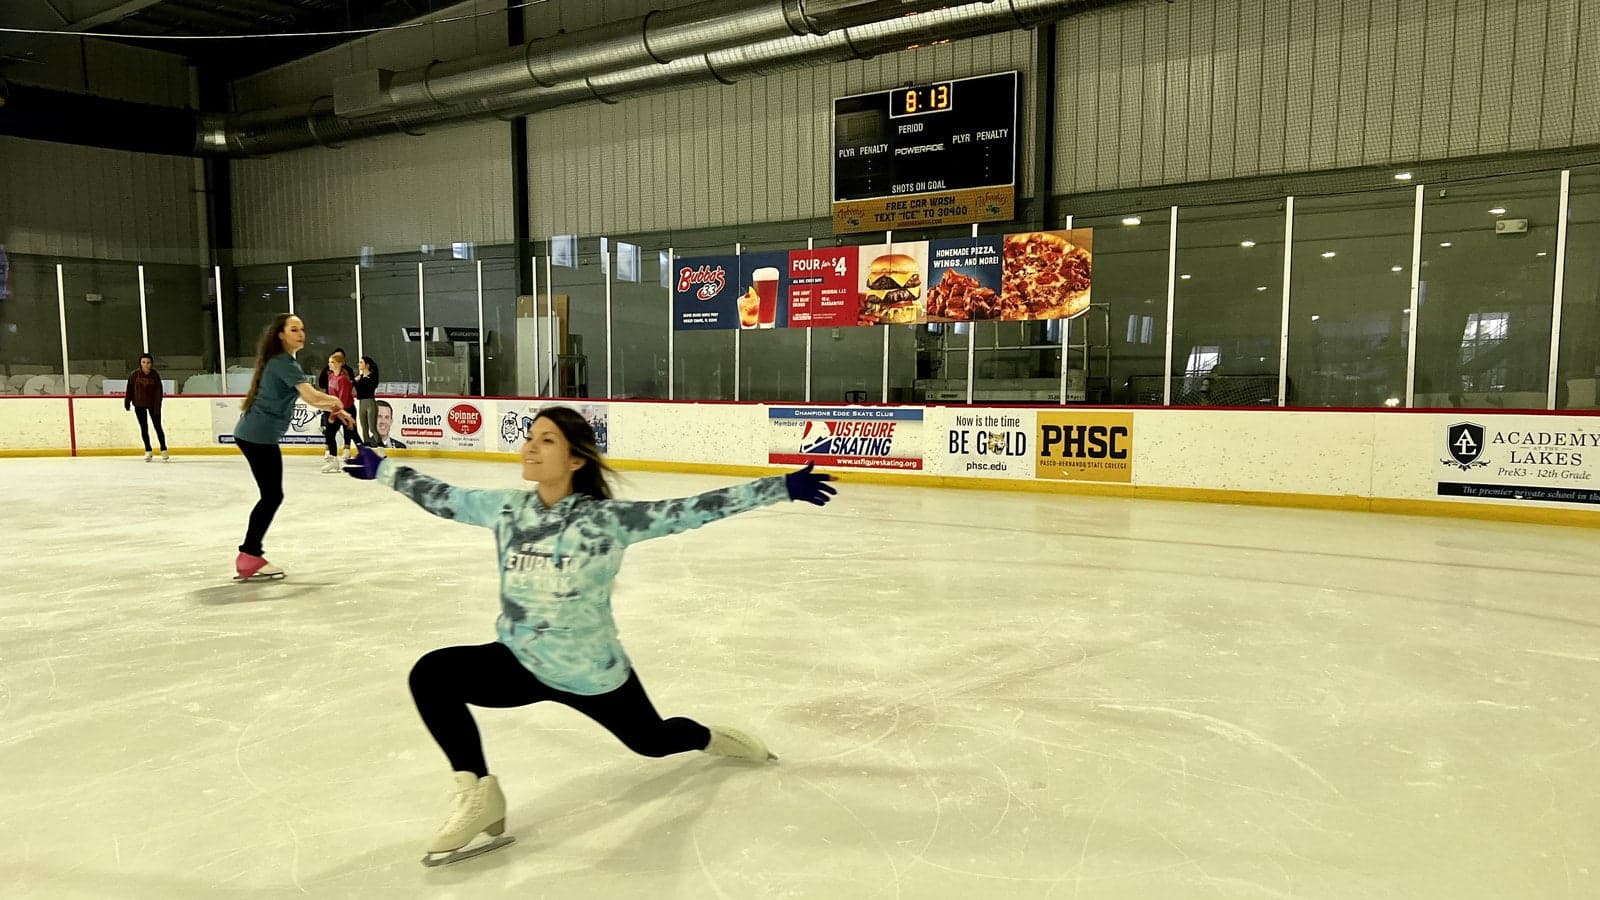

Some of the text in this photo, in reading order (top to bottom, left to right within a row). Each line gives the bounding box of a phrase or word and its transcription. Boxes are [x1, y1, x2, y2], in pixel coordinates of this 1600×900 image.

[906, 86, 948, 112] 8:13
[898, 122, 924, 135] PERIOD
[952, 128, 1009, 145] PLYR PENALTY
[838, 143, 889, 159] PLYR PENALTY
[894, 143, 945, 156] POWERADE
[891, 179, 947, 194] SHOTS ON GOAL
[885, 196, 956, 211] FREE CAR WASH
[874, 211, 896, 223] TEXT
[923, 208, 935, 219] TO
[938, 206, 968, 217] 30400
[936, 247, 970, 258] HOMEMADE
[792, 256, 847, 276] FOUR for $4
[933, 256, 999, 269] WINGS, AND MORE!
[677, 264, 726, 293] Bubba's
[701, 283, 718, 297] 33
[412, 403, 431, 414] Auto
[402, 414, 442, 426] Accident?
[449, 410, 479, 422] Spinner
[956, 414, 1020, 428] Now is the time
[836, 422, 896, 438] US FIGURE
[831, 437, 892, 456] SKATING
[949, 430, 970, 454] BE
[1041, 424, 1128, 460] PHSC
[1492, 432, 1600, 447] ACADEMY
[836, 458, 917, 468] www.usfigureskating.org
[1510, 450, 1583, 466] LAKES
[966, 460, 1007, 472] phsc.edu
[1104, 462, 1127, 470] COLLEGE
[1498, 467, 1527, 478] PreK3
[1537, 469, 1558, 479] 12th
[1560, 470, 1592, 480] Grade
[1463, 486, 1476, 494] The
[1479, 488, 1513, 497] premier
[1546, 490, 1576, 500] school
